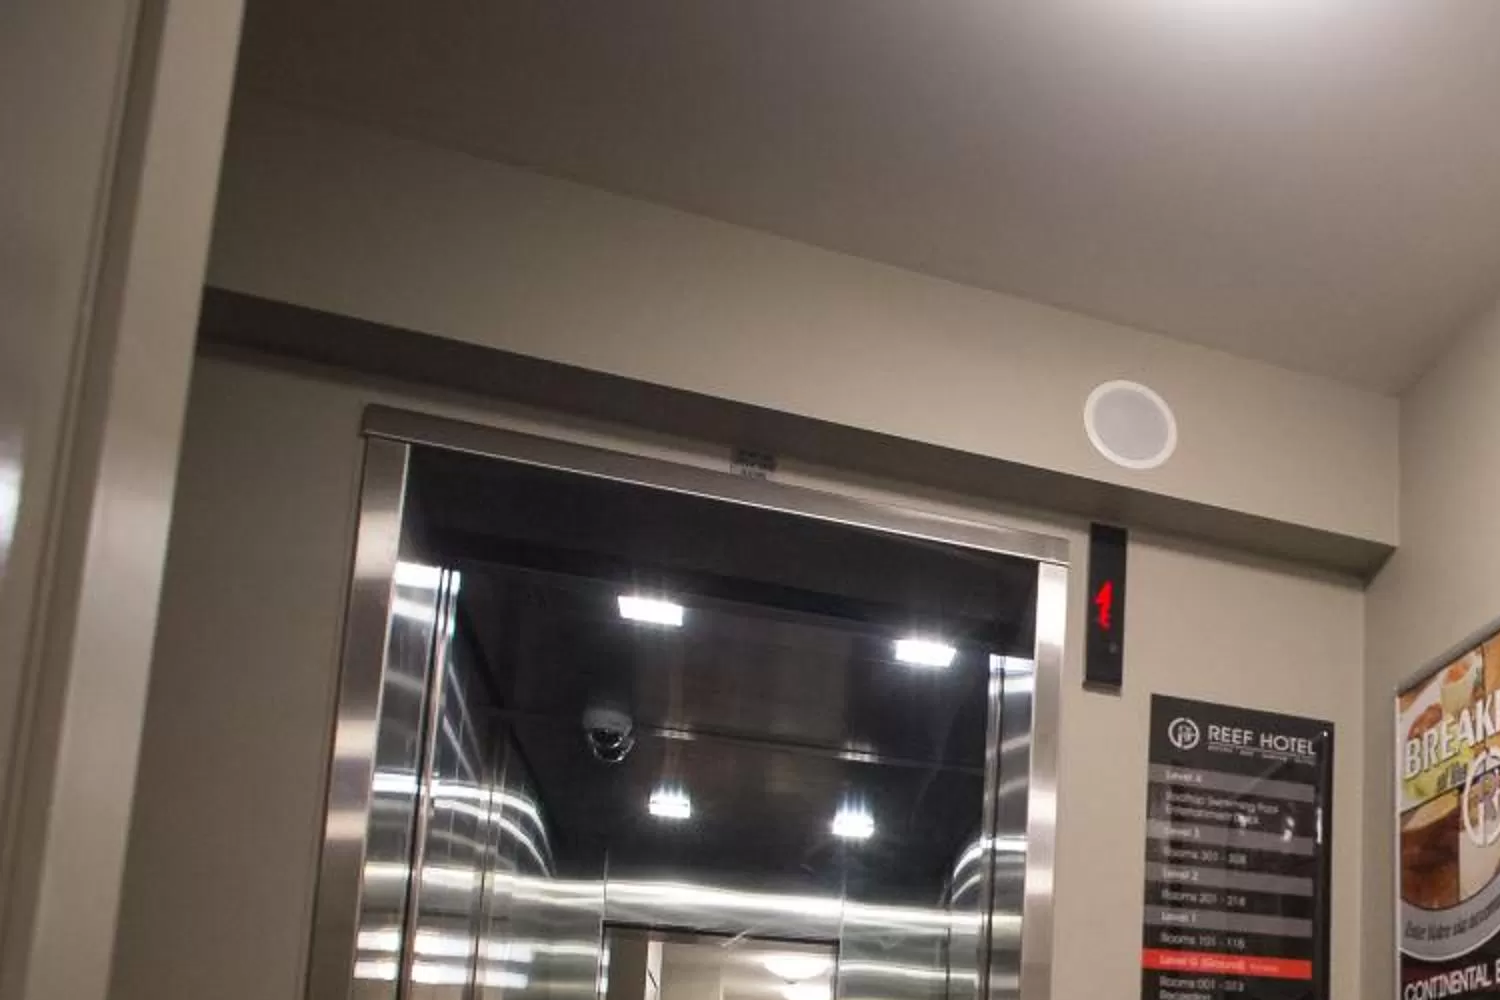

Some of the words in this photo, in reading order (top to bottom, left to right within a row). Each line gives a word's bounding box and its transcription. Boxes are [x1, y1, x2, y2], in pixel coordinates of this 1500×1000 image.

[1207, 724, 1254, 745] REEF
[1260, 732, 1317, 756] HOTEL
[1160, 910, 1189, 923] Level
[1160, 931, 1195, 945] Rooms
[1159, 976, 1195, 989] Rooms
